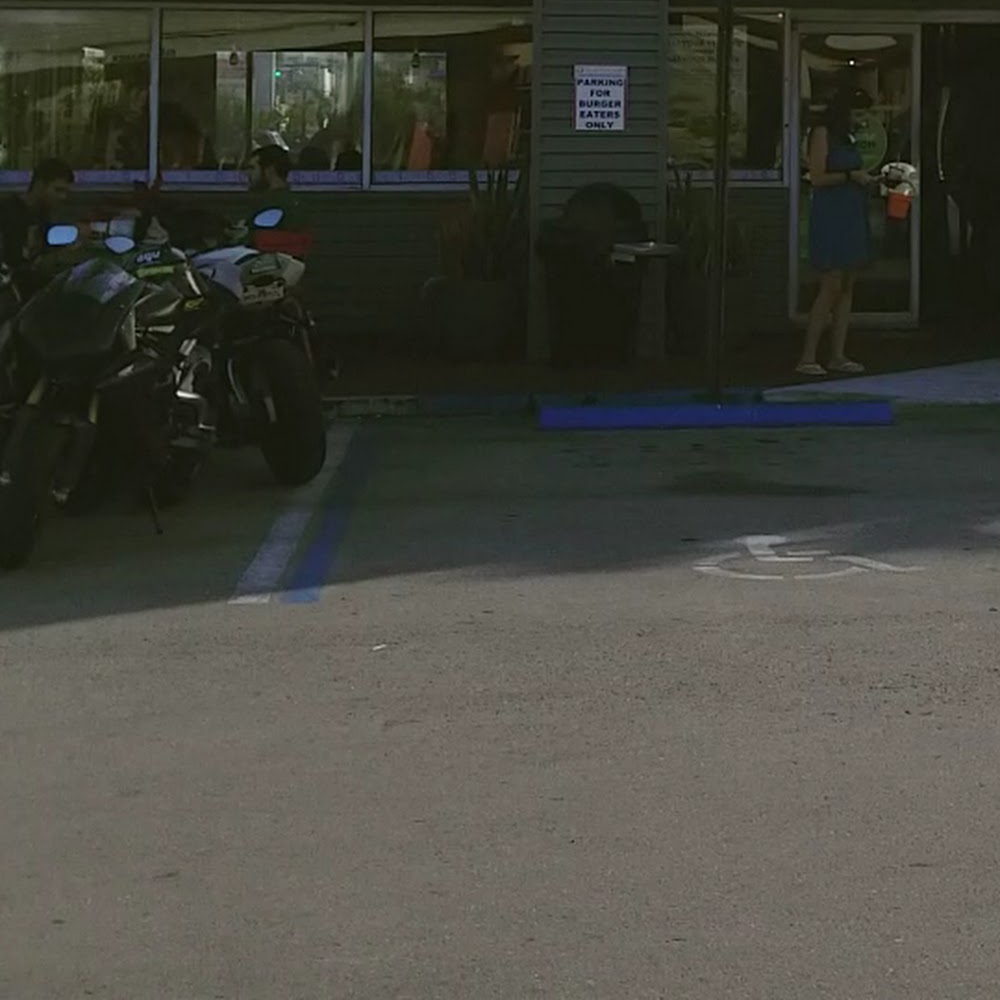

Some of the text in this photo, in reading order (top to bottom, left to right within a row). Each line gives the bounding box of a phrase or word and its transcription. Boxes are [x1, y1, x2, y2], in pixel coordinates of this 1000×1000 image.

[579, 100, 621, 108] BURGER
[580, 111, 620, 119] EATERS
[585, 121, 614, 129] ONLY
